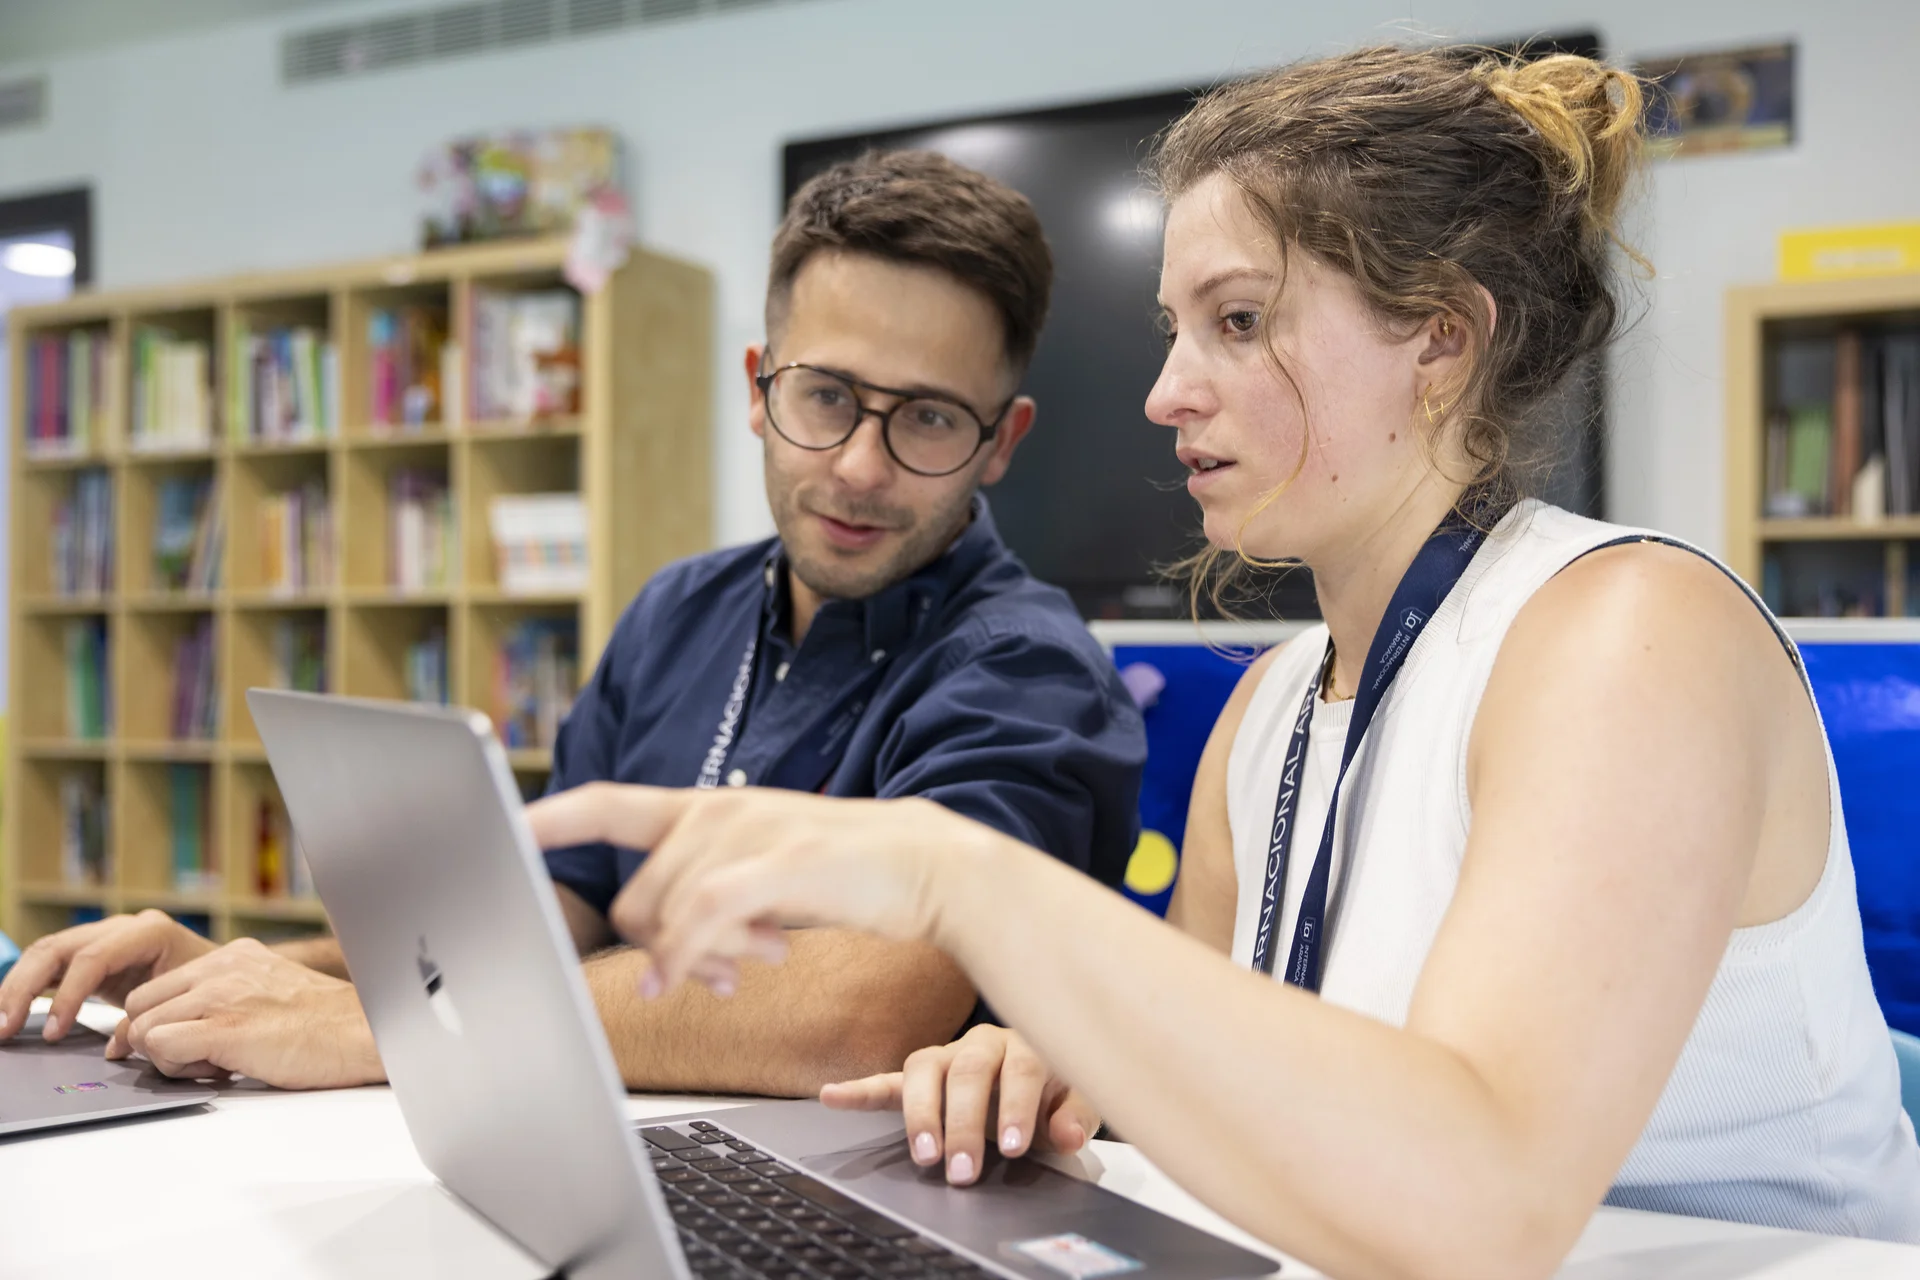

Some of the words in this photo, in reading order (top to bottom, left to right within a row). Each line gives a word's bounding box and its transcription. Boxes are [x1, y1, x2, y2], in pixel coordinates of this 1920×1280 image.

[1372, 634, 1411, 691] INTERNACIONAL
[1379, 629, 1403, 664] ARAVACA
[1294, 944, 1304, 982] ARAVACA
